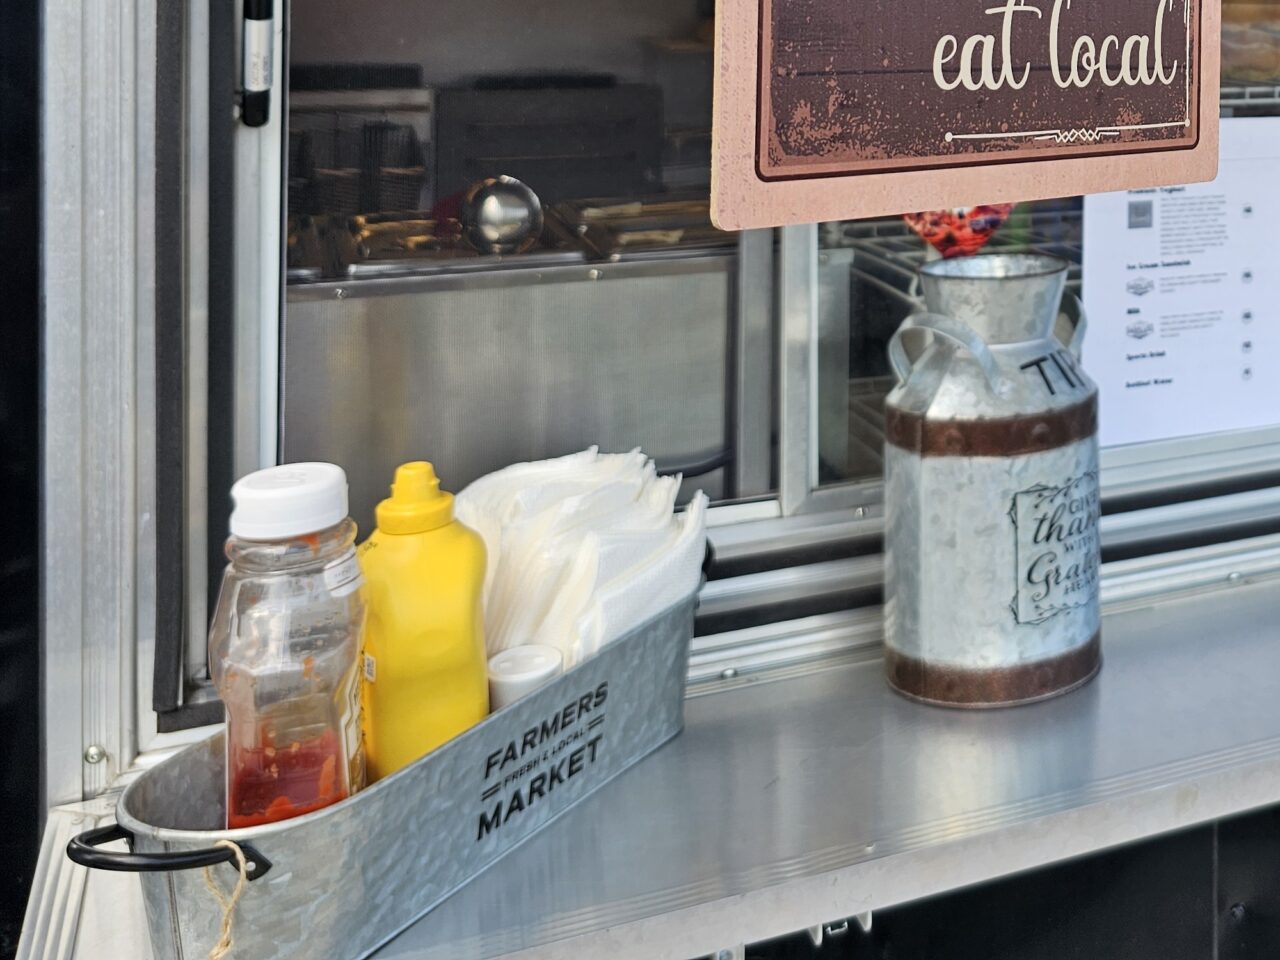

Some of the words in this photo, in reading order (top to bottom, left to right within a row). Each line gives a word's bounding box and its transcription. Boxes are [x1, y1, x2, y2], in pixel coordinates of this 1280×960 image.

[484, 680, 609, 780] FARMERS
[503, 758, 541, 789] FRESH
[551, 727, 585, 757] LOCAL
[476, 731, 603, 843] MARKET
